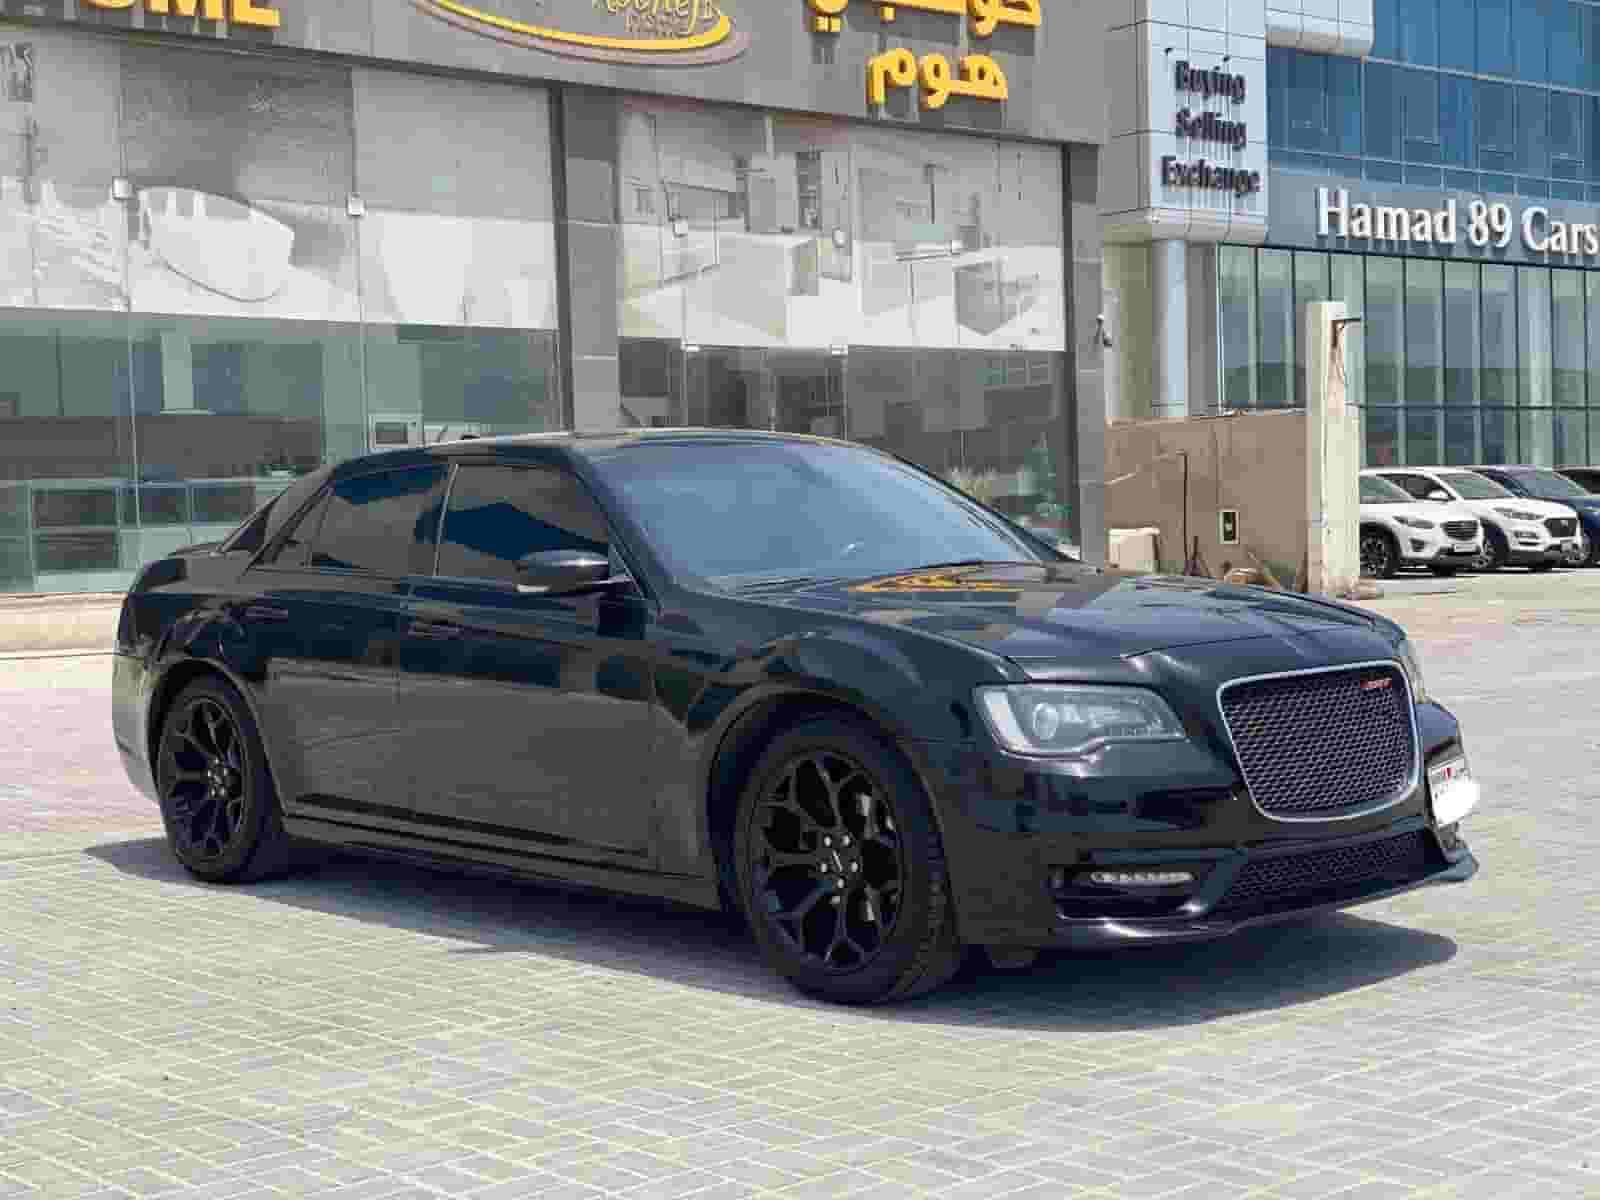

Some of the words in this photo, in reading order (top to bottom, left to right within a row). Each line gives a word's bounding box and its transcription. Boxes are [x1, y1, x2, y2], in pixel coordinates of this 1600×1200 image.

[866, 48, 1008, 108] هوم
[1175, 60, 1245, 104] Buying
[1175, 108, 1247, 151] Selling
[1160, 155, 1261, 198] Exchange
[1316, 187, 1457, 243] Hamad
[1468, 199, 1513, 247] 89
[1520, 205, 1600, 255] Cars
